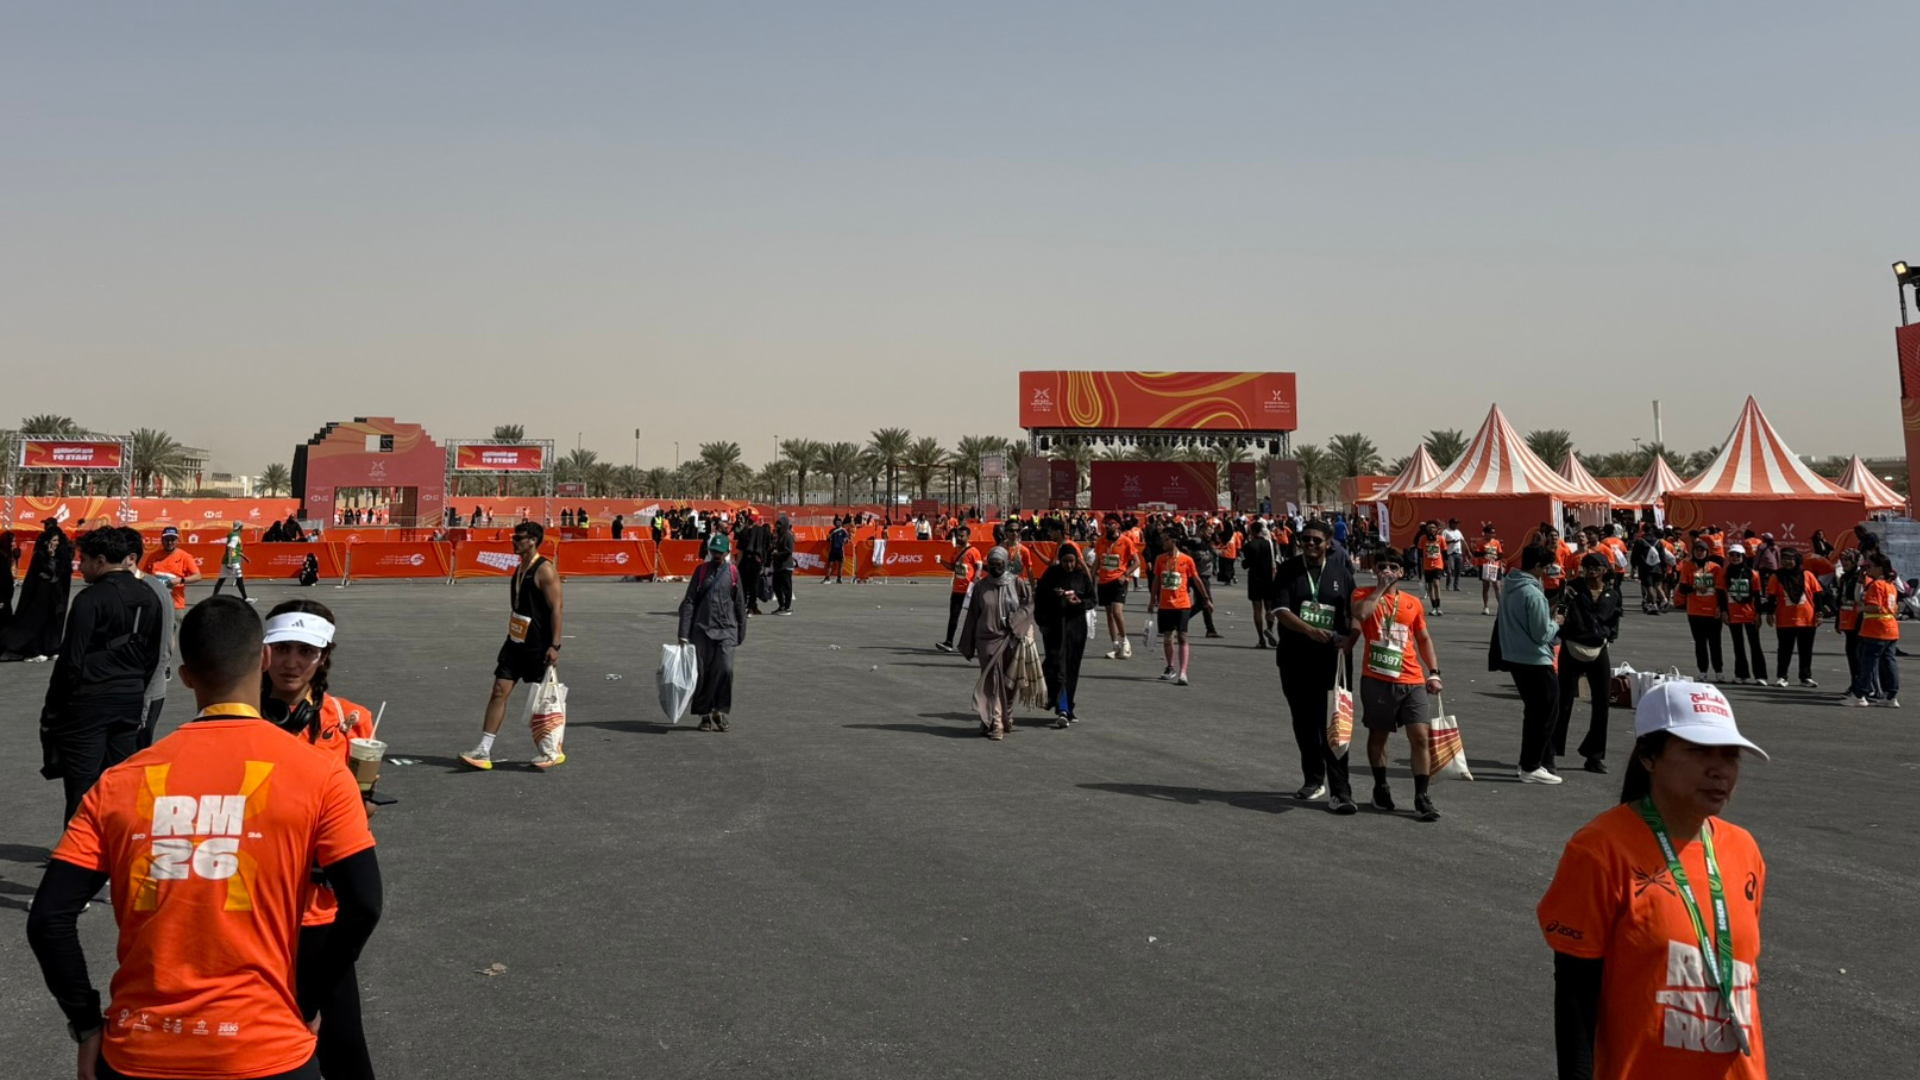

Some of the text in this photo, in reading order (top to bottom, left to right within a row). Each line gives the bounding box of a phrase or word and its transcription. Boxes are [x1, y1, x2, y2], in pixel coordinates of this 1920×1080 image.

[898, 554, 924, 563] asics
[1302, 611, 1332, 625] 21117
[1372, 651, 1400, 667] 19397
[151, 794, 247, 836] RM
[131, 832, 146, 840] 20
[150, 837, 240, 880] 26
[1558, 925, 1585, 940] asics
